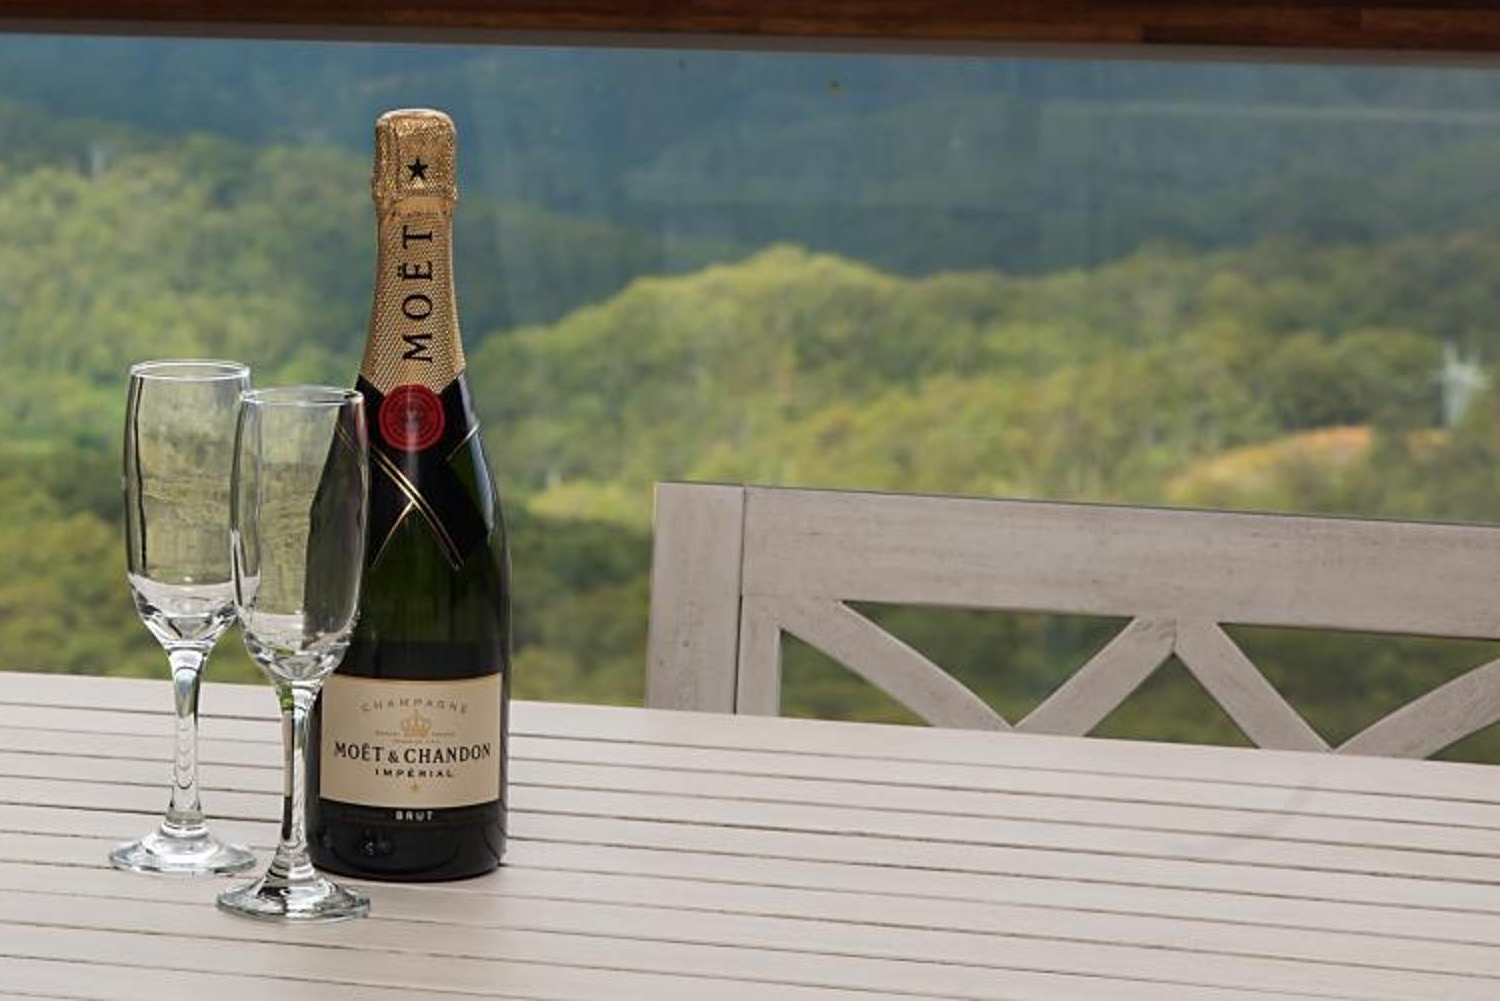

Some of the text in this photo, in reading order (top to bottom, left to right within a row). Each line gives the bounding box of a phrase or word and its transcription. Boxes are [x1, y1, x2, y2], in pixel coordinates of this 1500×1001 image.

[398, 224, 433, 363] MOËT
[359, 697, 467, 714] CHAMPAGNE
[387, 750, 399, 763] &
[403, 742, 491, 763] CHANDON
[395, 810, 433, 821] BRUT
